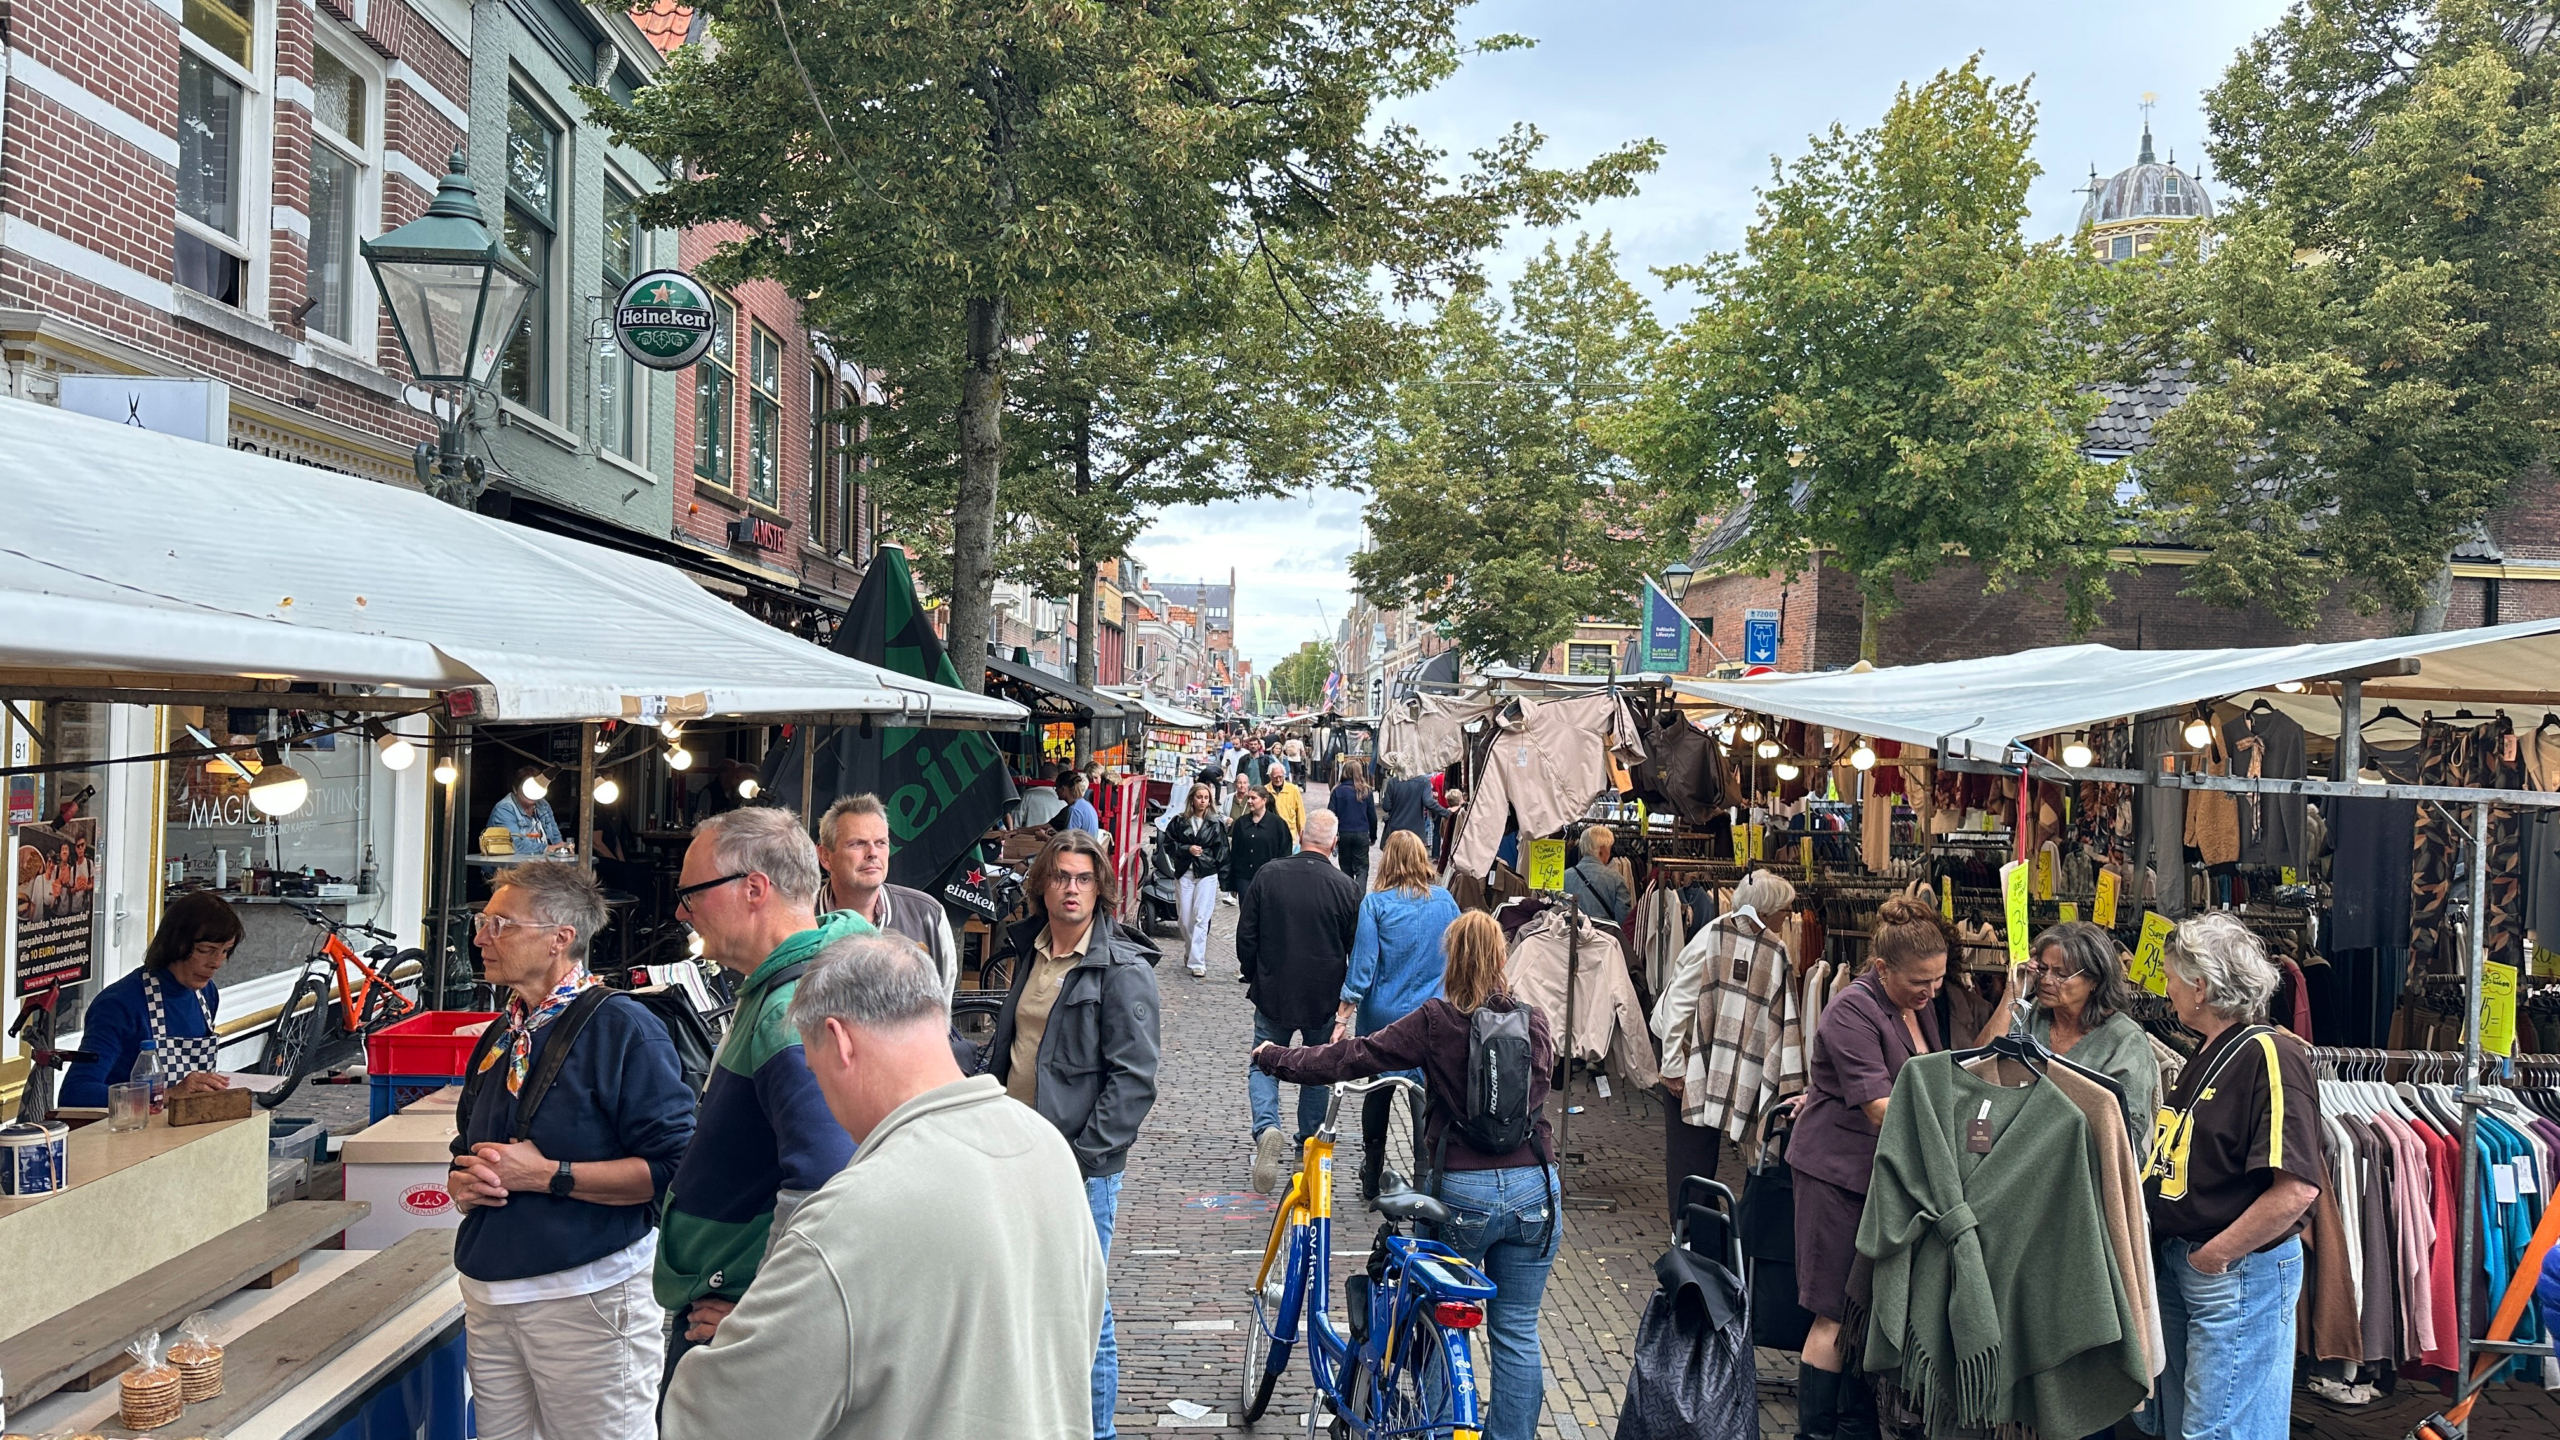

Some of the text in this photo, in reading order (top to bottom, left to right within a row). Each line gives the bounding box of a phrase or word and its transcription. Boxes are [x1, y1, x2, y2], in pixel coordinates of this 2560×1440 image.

[621, 308, 707, 328] Heineken
[15, 742, 26, 759] 81
[188, 794, 261, 831] MAGIC
[251, 820, 318, 839] ALLROUND KAPPER
[944, 883, 997, 912] eineken
[17, 926, 89, 948] megahit onder toeristen
[18, 919, 50, 934] Hollandse
[20, 940, 87, 962] die 10 EURO neertellen
[17, 952, 89, 978] voor een armoedekoekje
[1489, 1049, 1498, 1115] ROCKRIDER
[412, 1192, 443, 1206] L&S
[1308, 1225, 1317, 1290] OV-fiets
